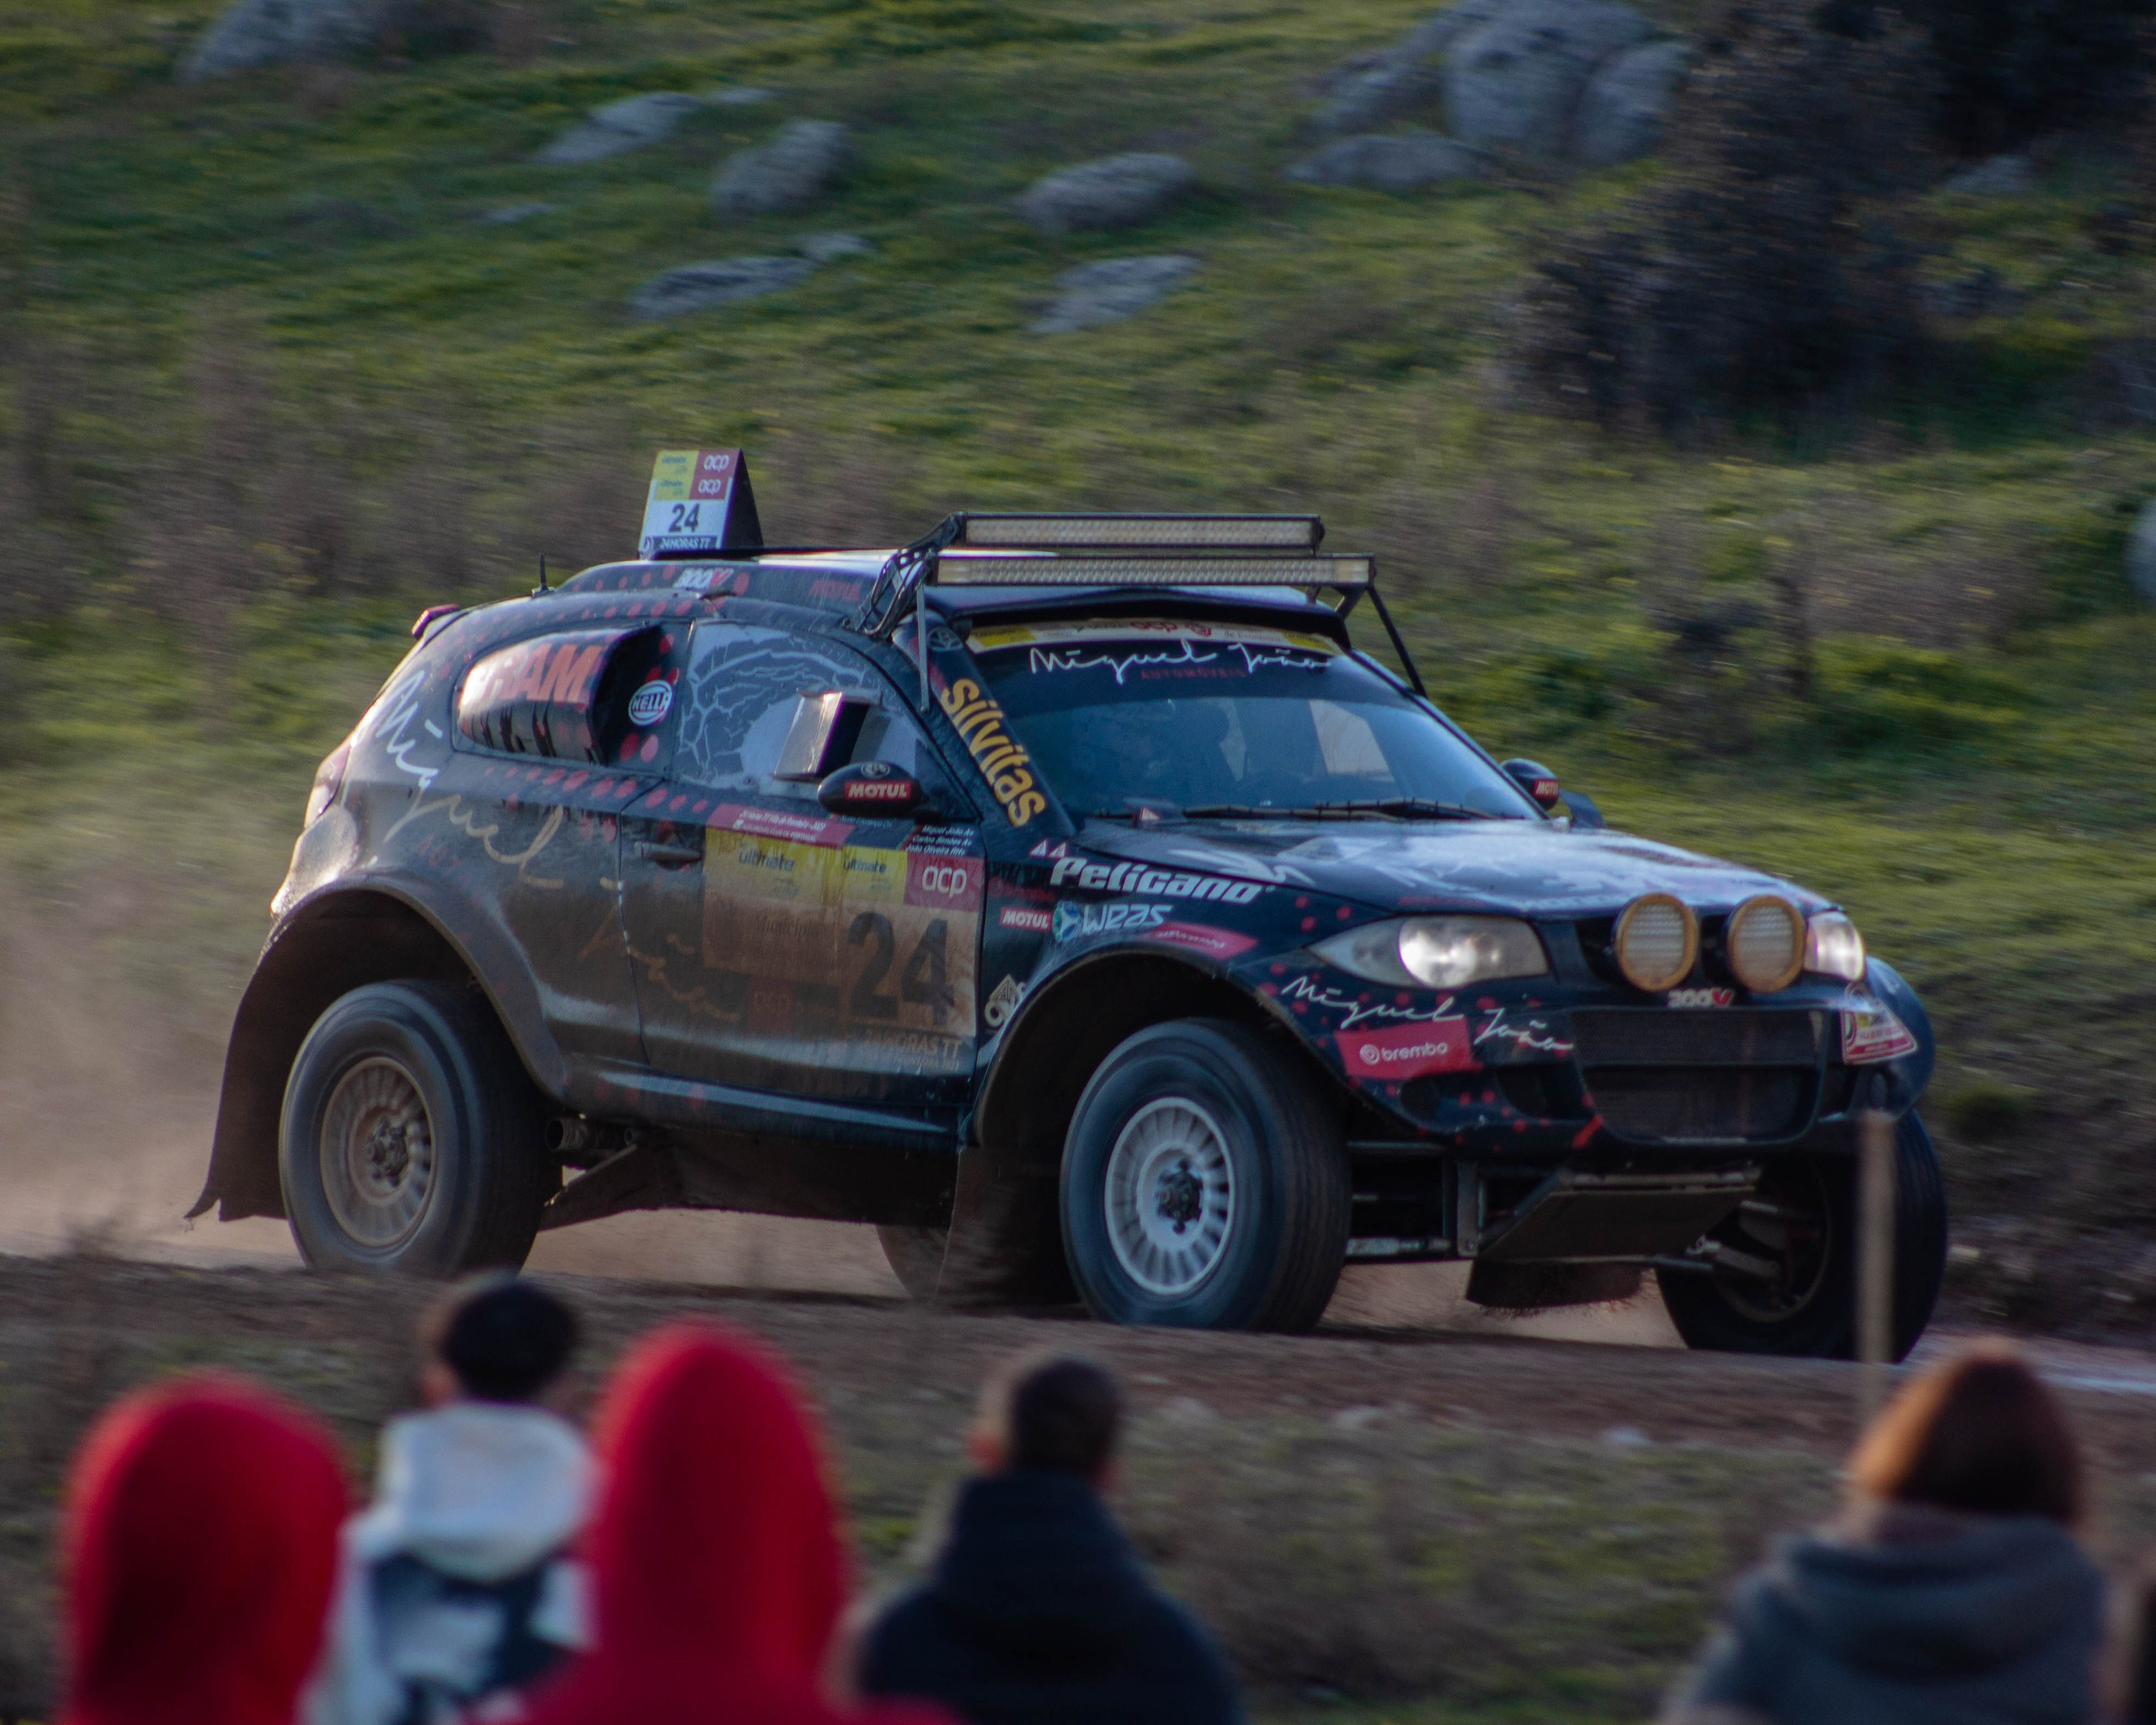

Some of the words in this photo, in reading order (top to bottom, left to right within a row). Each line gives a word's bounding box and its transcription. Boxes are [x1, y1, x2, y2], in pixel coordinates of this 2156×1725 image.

[668, 503, 701, 532] 24
[1029, 637, 1219, 685] Miguel
[940, 678, 1046, 828] silvitas
[848, 783, 907, 798] MOTUL
[921, 865, 967, 899] acp
[1049, 856, 1263, 905] Pelicano
[1002, 910, 1049, 929] MOTUL
[847, 910, 955, 1026] 24
[1281, 975, 1465, 1028] Miguel
[1381, 1041, 1448, 1062] brembo
